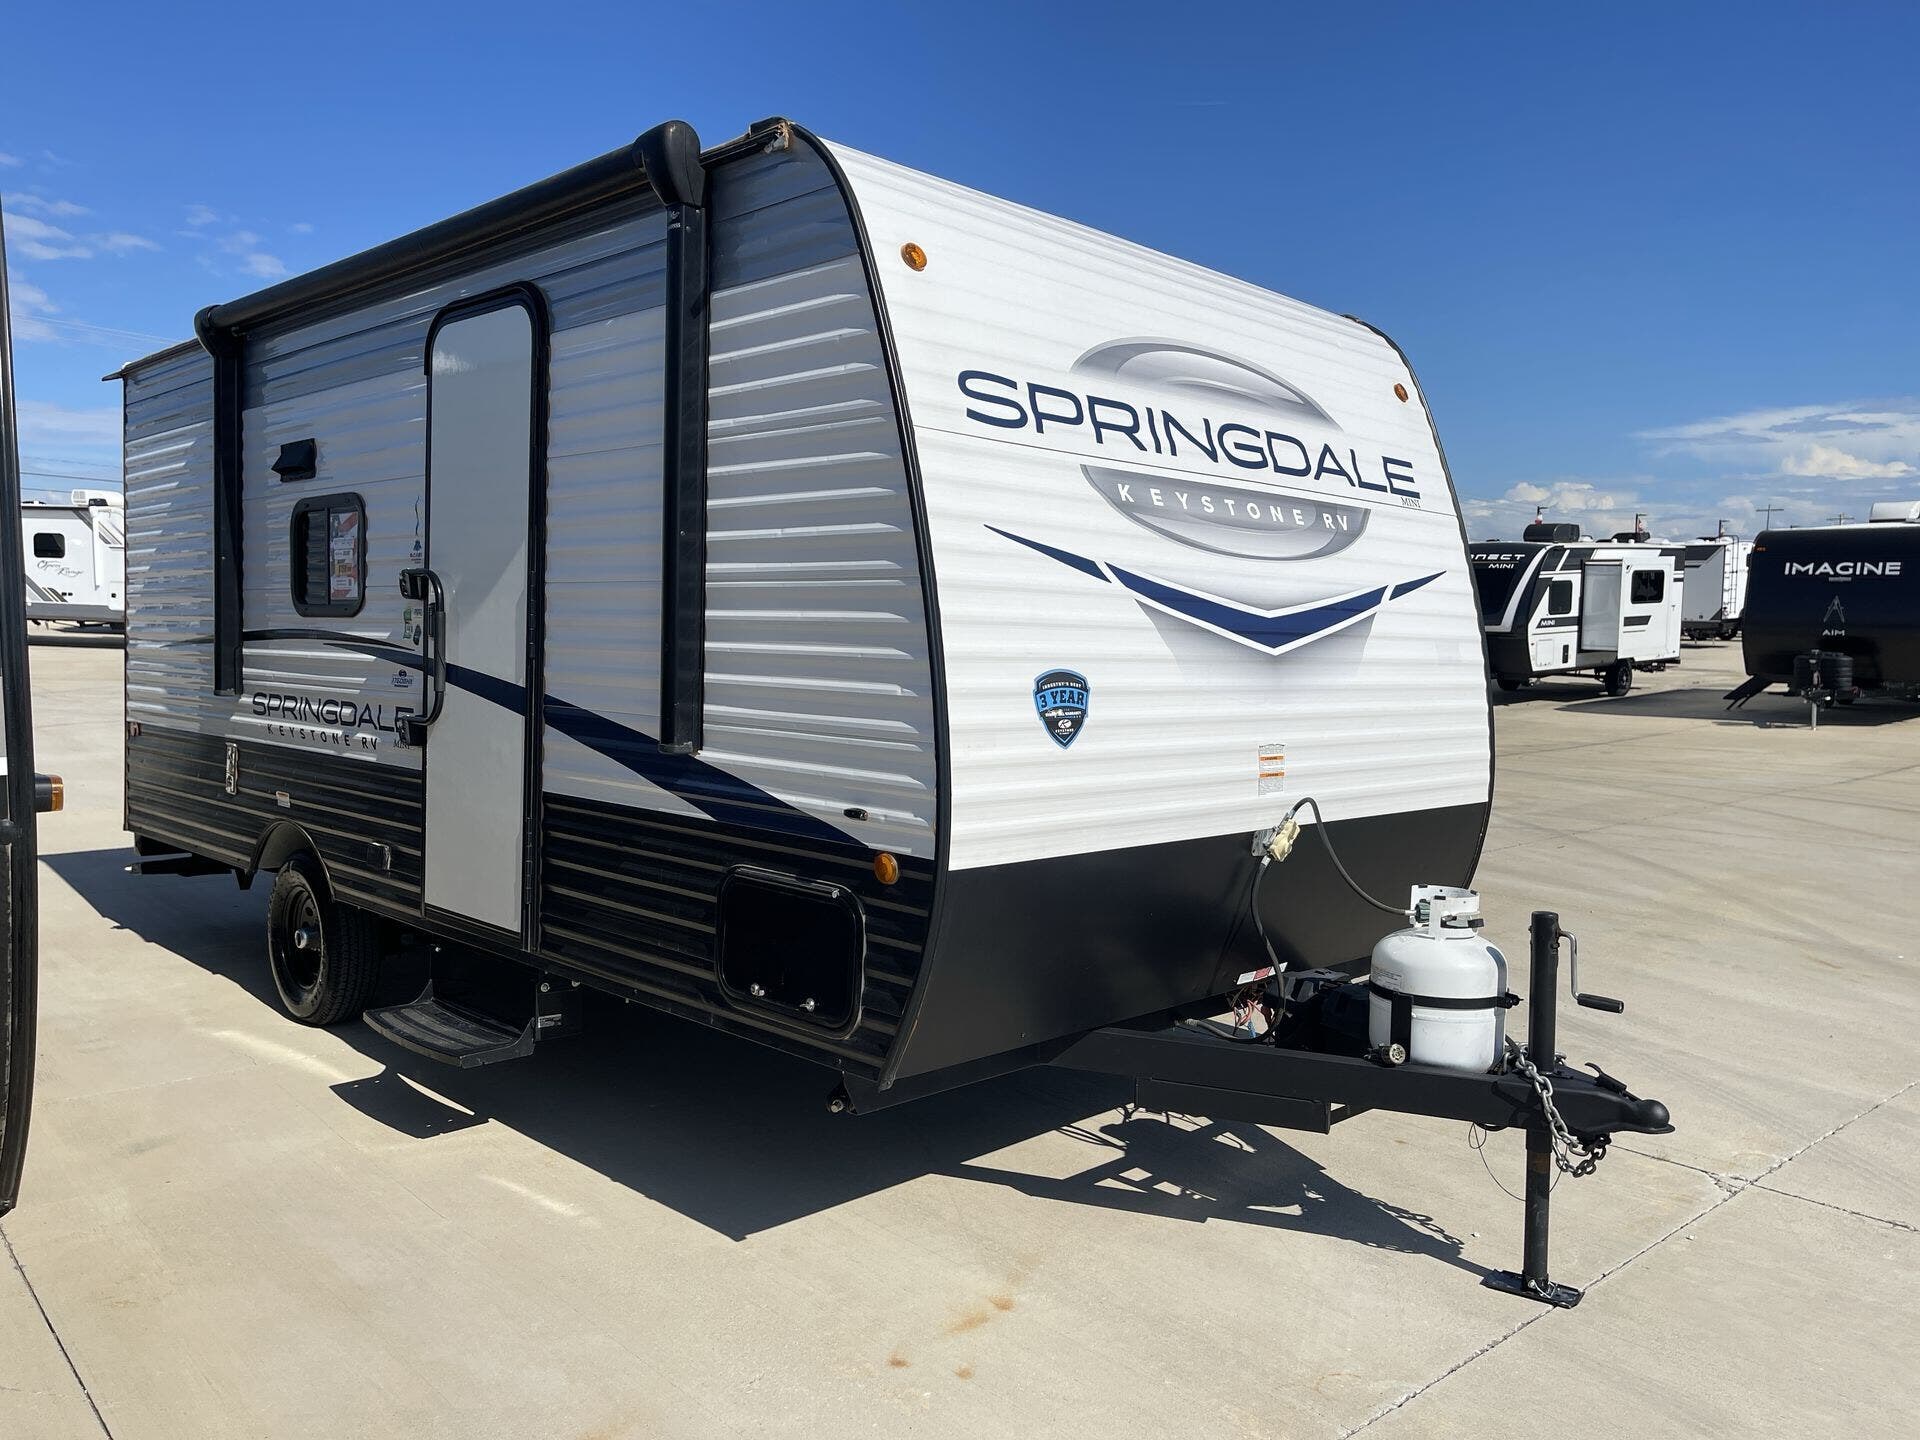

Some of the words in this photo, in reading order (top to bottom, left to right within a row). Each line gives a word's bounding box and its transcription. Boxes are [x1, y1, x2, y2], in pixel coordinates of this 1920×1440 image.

[958, 370, 1421, 499] SPRINGDALE
[1117, 484, 1305, 525] KEYSTONE
[1323, 513, 1348, 531] RV
[1400, 496, 1421, 508] MINI
[1784, 562, 1901, 575] IMAGINE
[1039, 694, 1047, 708] 3
[1050, 689, 1084, 706] YEAR
[267, 724, 351, 746] KEYSTONE
[361, 737, 378, 750] RV
